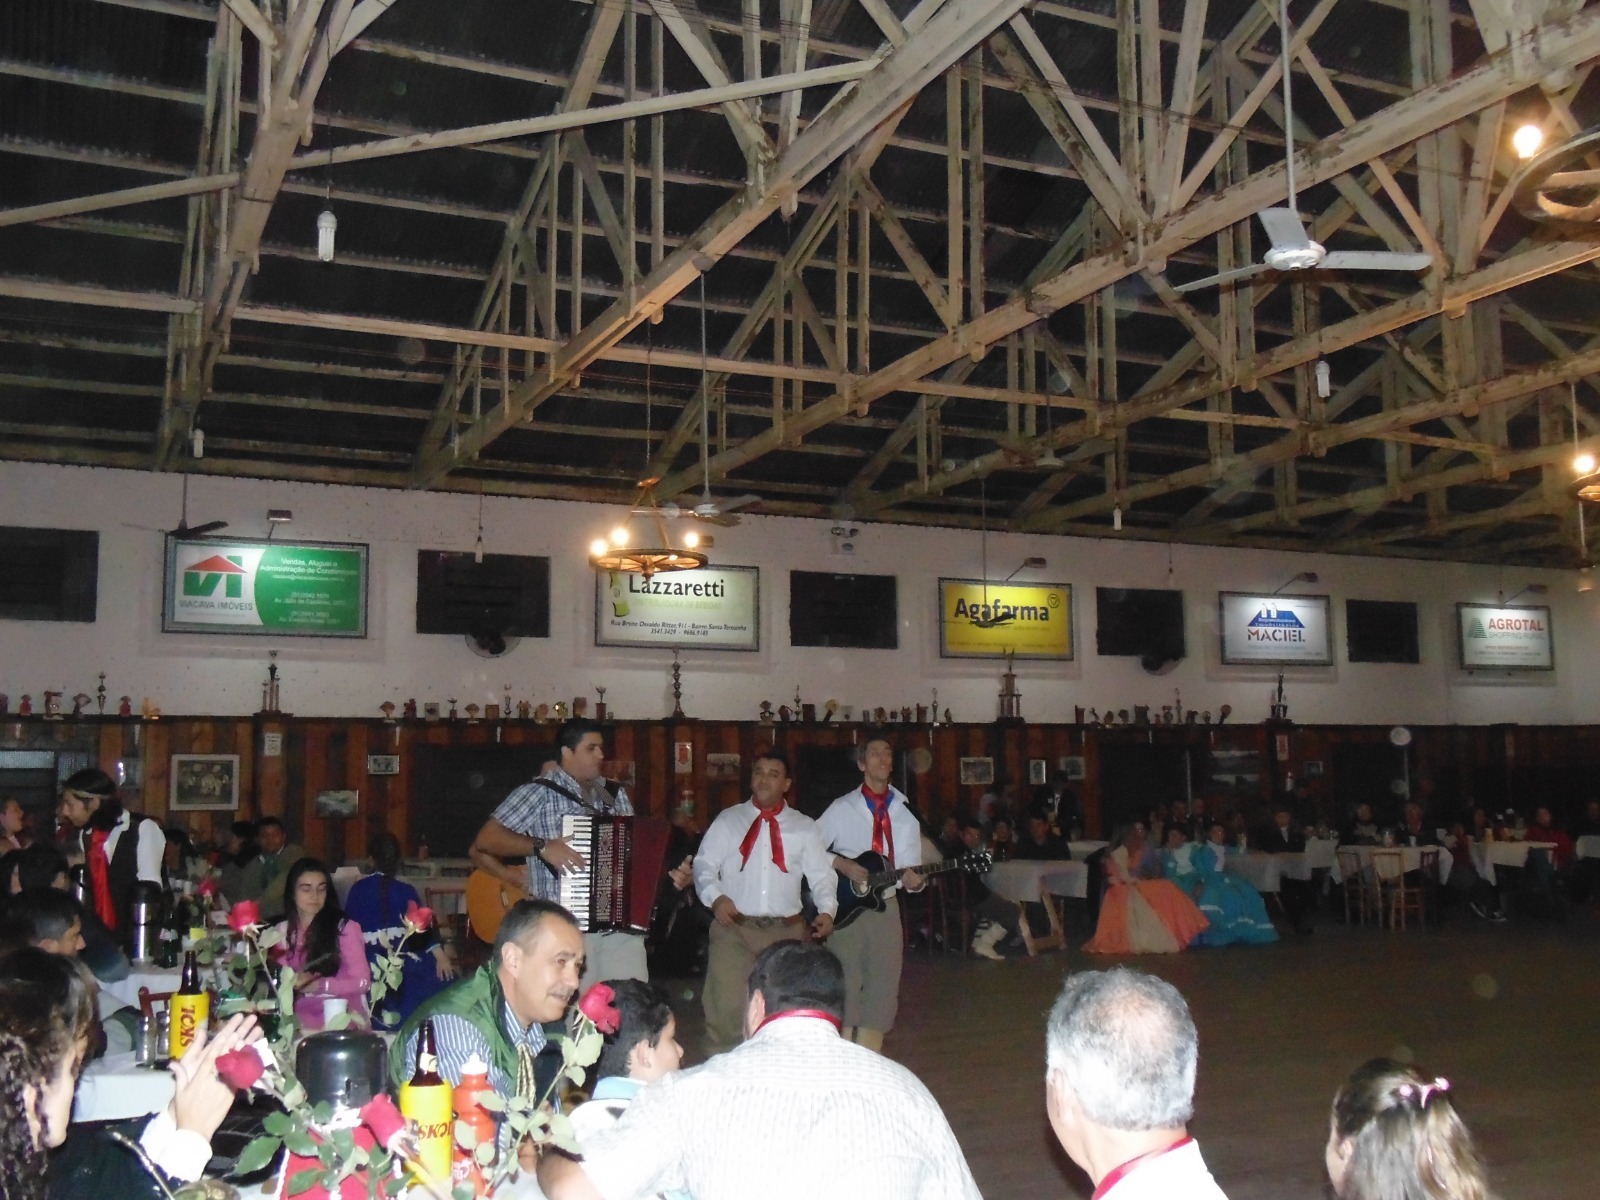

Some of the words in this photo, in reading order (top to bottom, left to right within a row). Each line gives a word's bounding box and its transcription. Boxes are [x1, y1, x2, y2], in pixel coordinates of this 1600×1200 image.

[629, 574, 725, 598] Lazzaretti
[954, 598, 1049, 622] Agafarma
[1247, 628, 1306, 643] MACIEL
[1488, 618, 1545, 632] AGROTAL
[180, 1004, 196, 1047] SKOL
